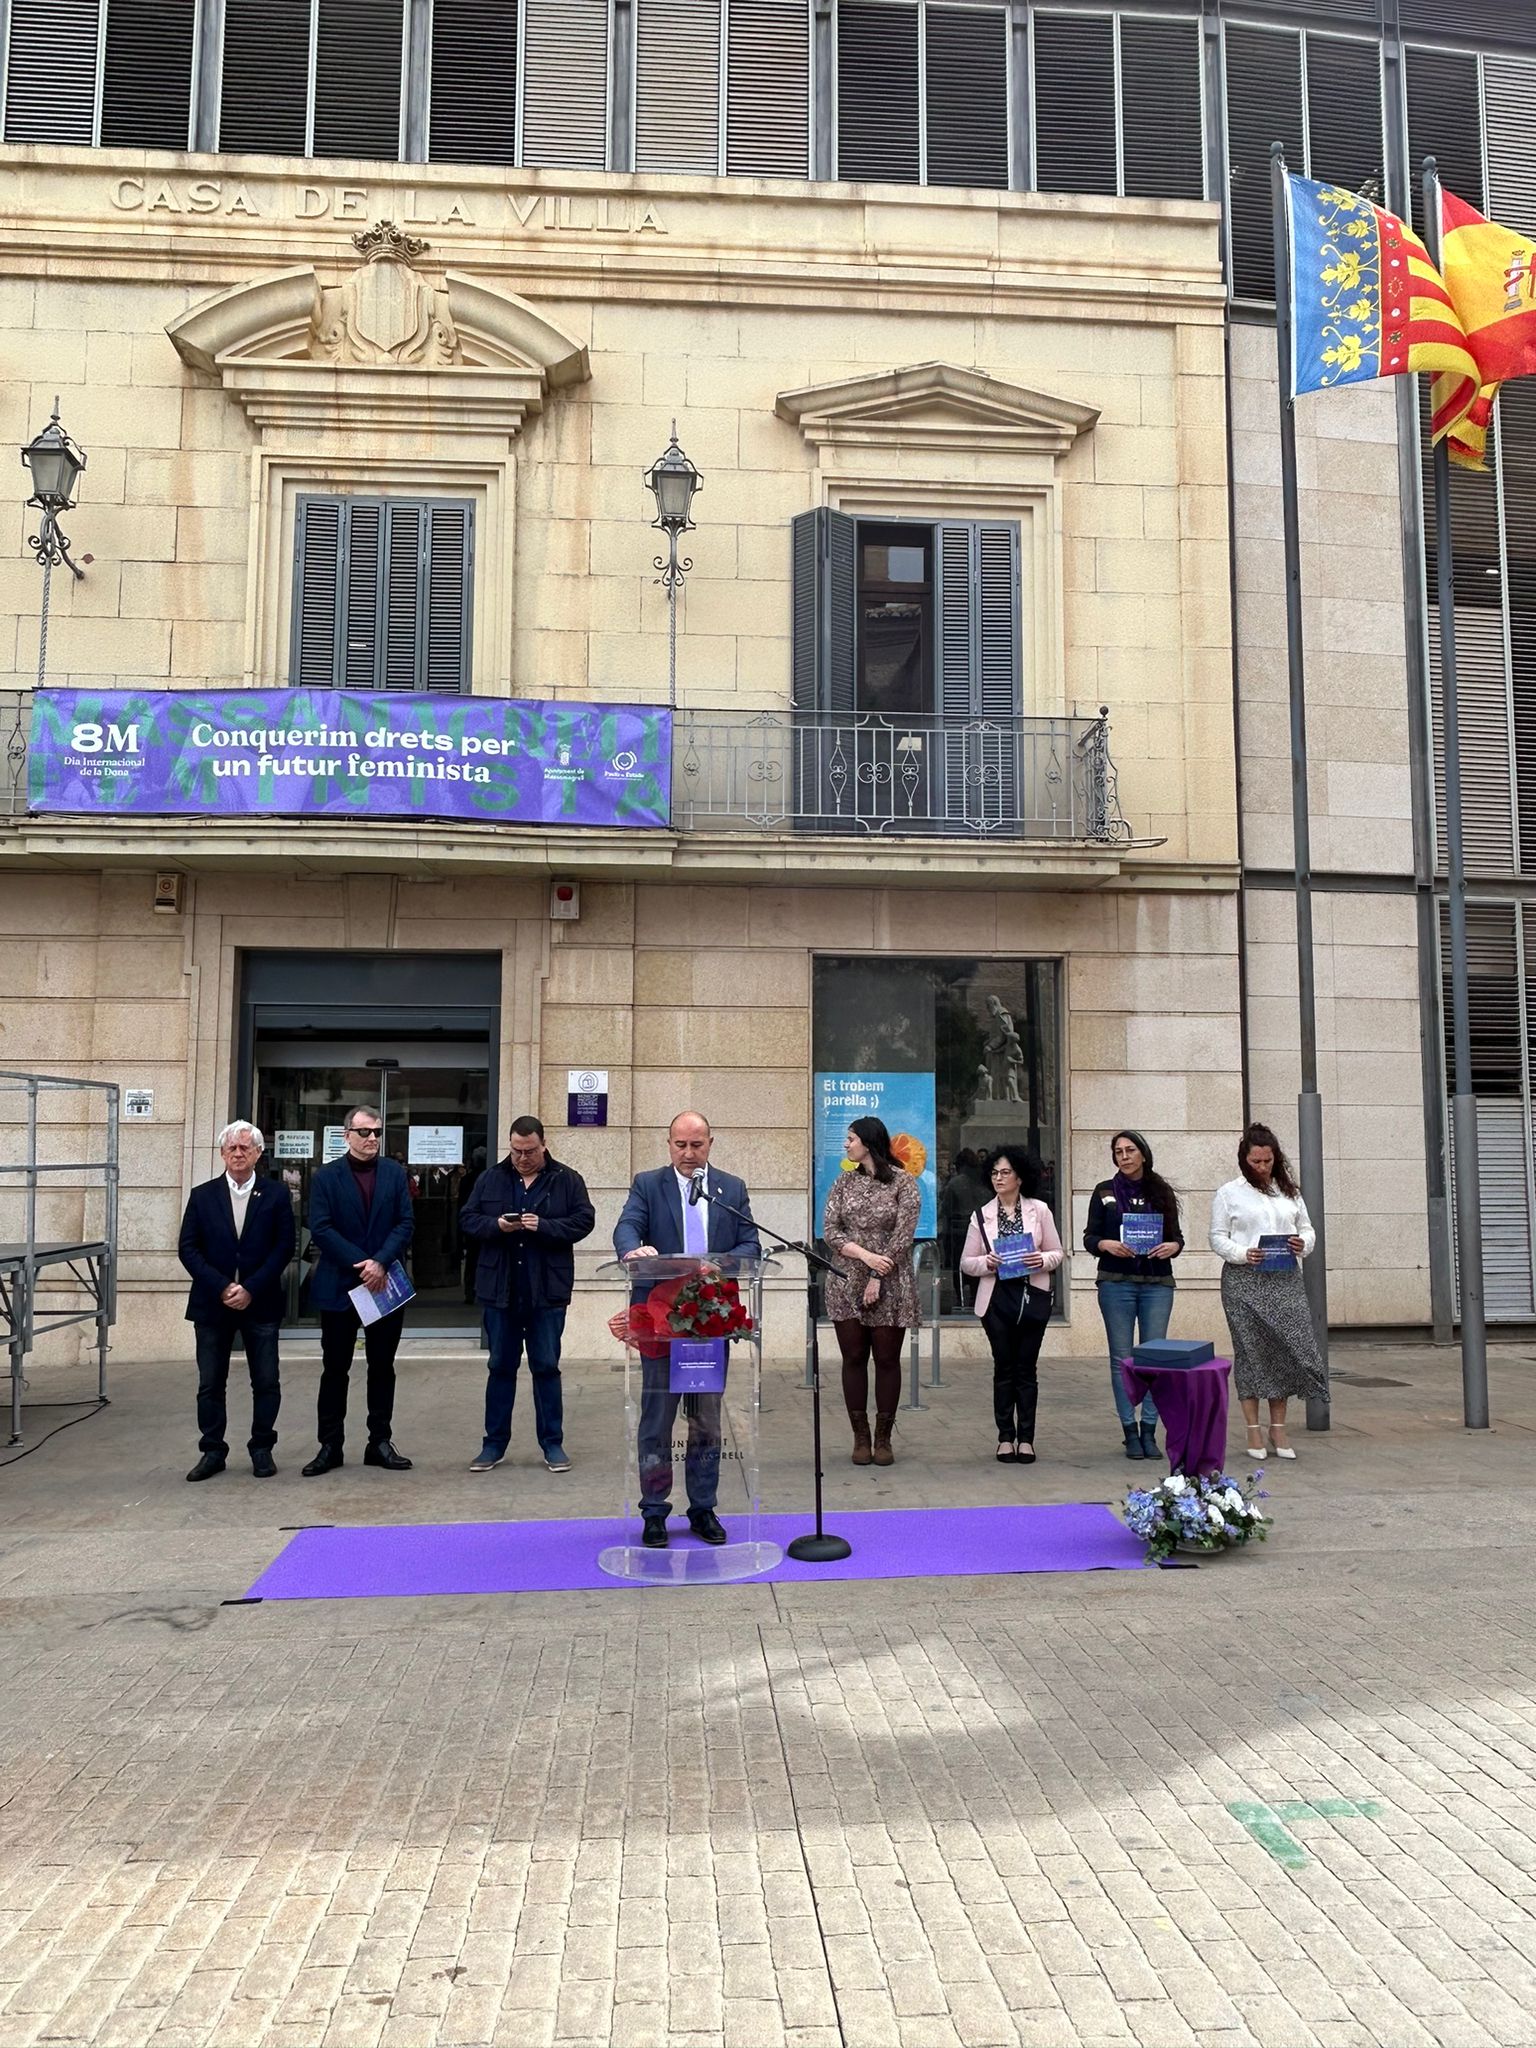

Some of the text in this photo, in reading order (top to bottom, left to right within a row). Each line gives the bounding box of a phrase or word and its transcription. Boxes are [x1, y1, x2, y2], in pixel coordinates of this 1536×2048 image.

[110, 177, 669, 234] CASA DE LA VILLA
[70, 723, 140, 753] 8M
[192, 723, 515, 757] Conquerim drets per
[79, 767, 129, 776] de la Dona
[83, 757, 145, 767] Internacional
[212, 754, 492, 784] un futur feminista
[823, 1079, 884, 1092] Et trobem
[823, 1094, 867, 1109] parella
